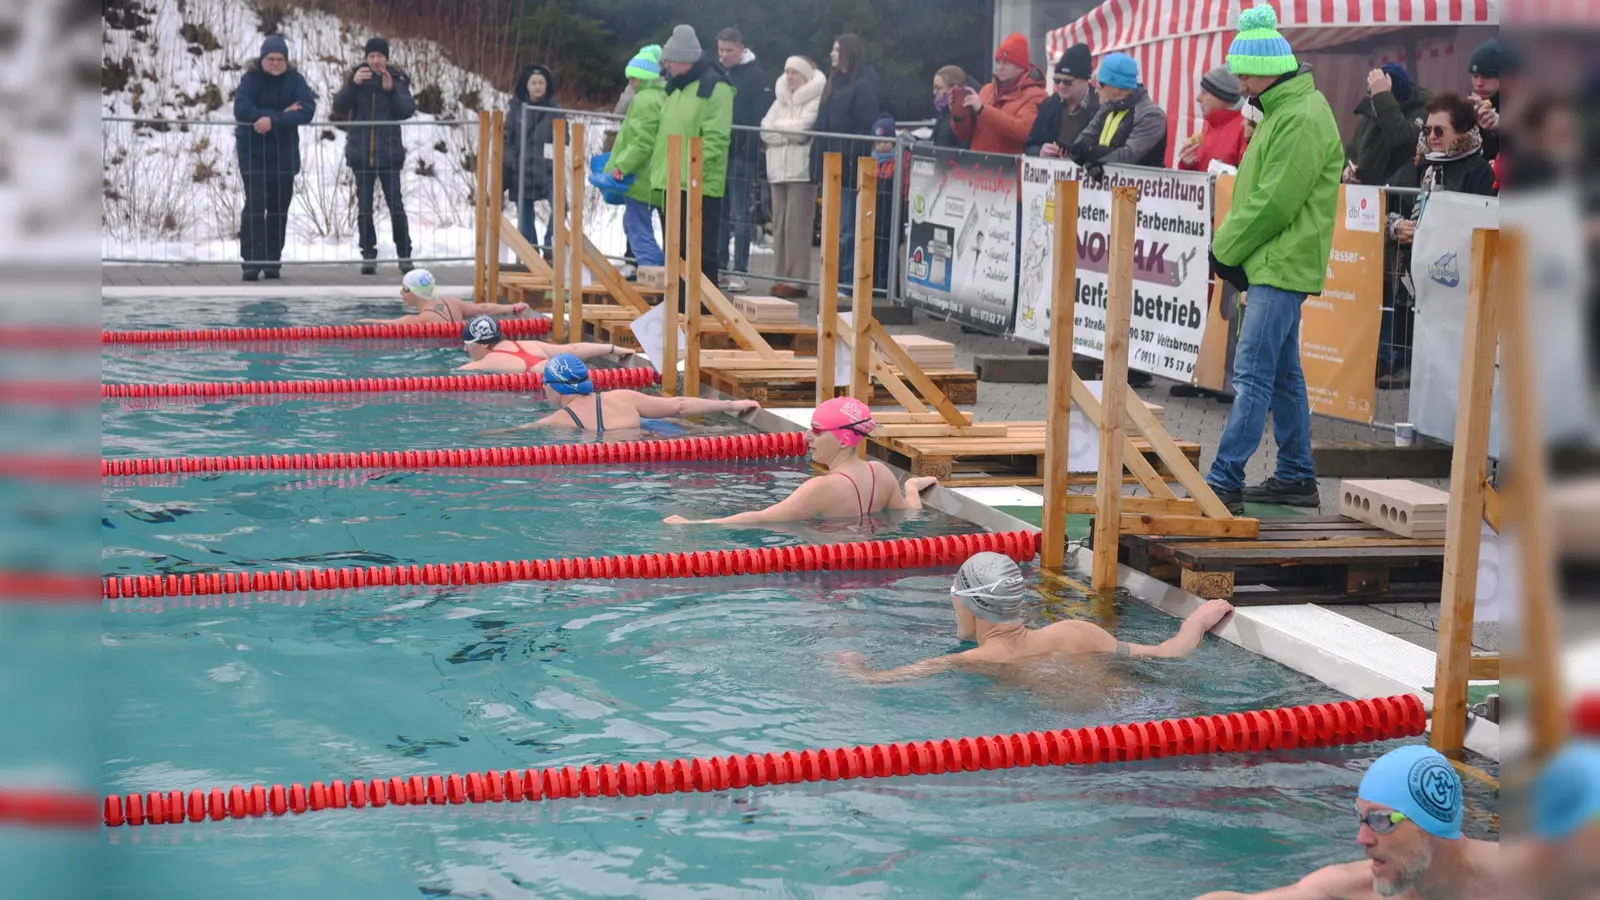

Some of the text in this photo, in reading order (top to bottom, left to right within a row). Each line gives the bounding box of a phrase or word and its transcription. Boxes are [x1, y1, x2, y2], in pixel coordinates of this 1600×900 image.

[1024, 163, 1050, 184] Raum-
[1137, 210, 1205, 237] Farbenhaus
[1077, 231, 1169, 273] NOAK
[996, 313, 1006, 326] 71
[1128, 327, 1139, 340] 90
[1141, 329, 1154, 343] 587
[1157, 333, 1199, 354] Veitsbronn
[1140, 350, 1155, 365] 0911
[1164, 356, 1174, 369] 75
[1175, 360, 1184, 371] 57
